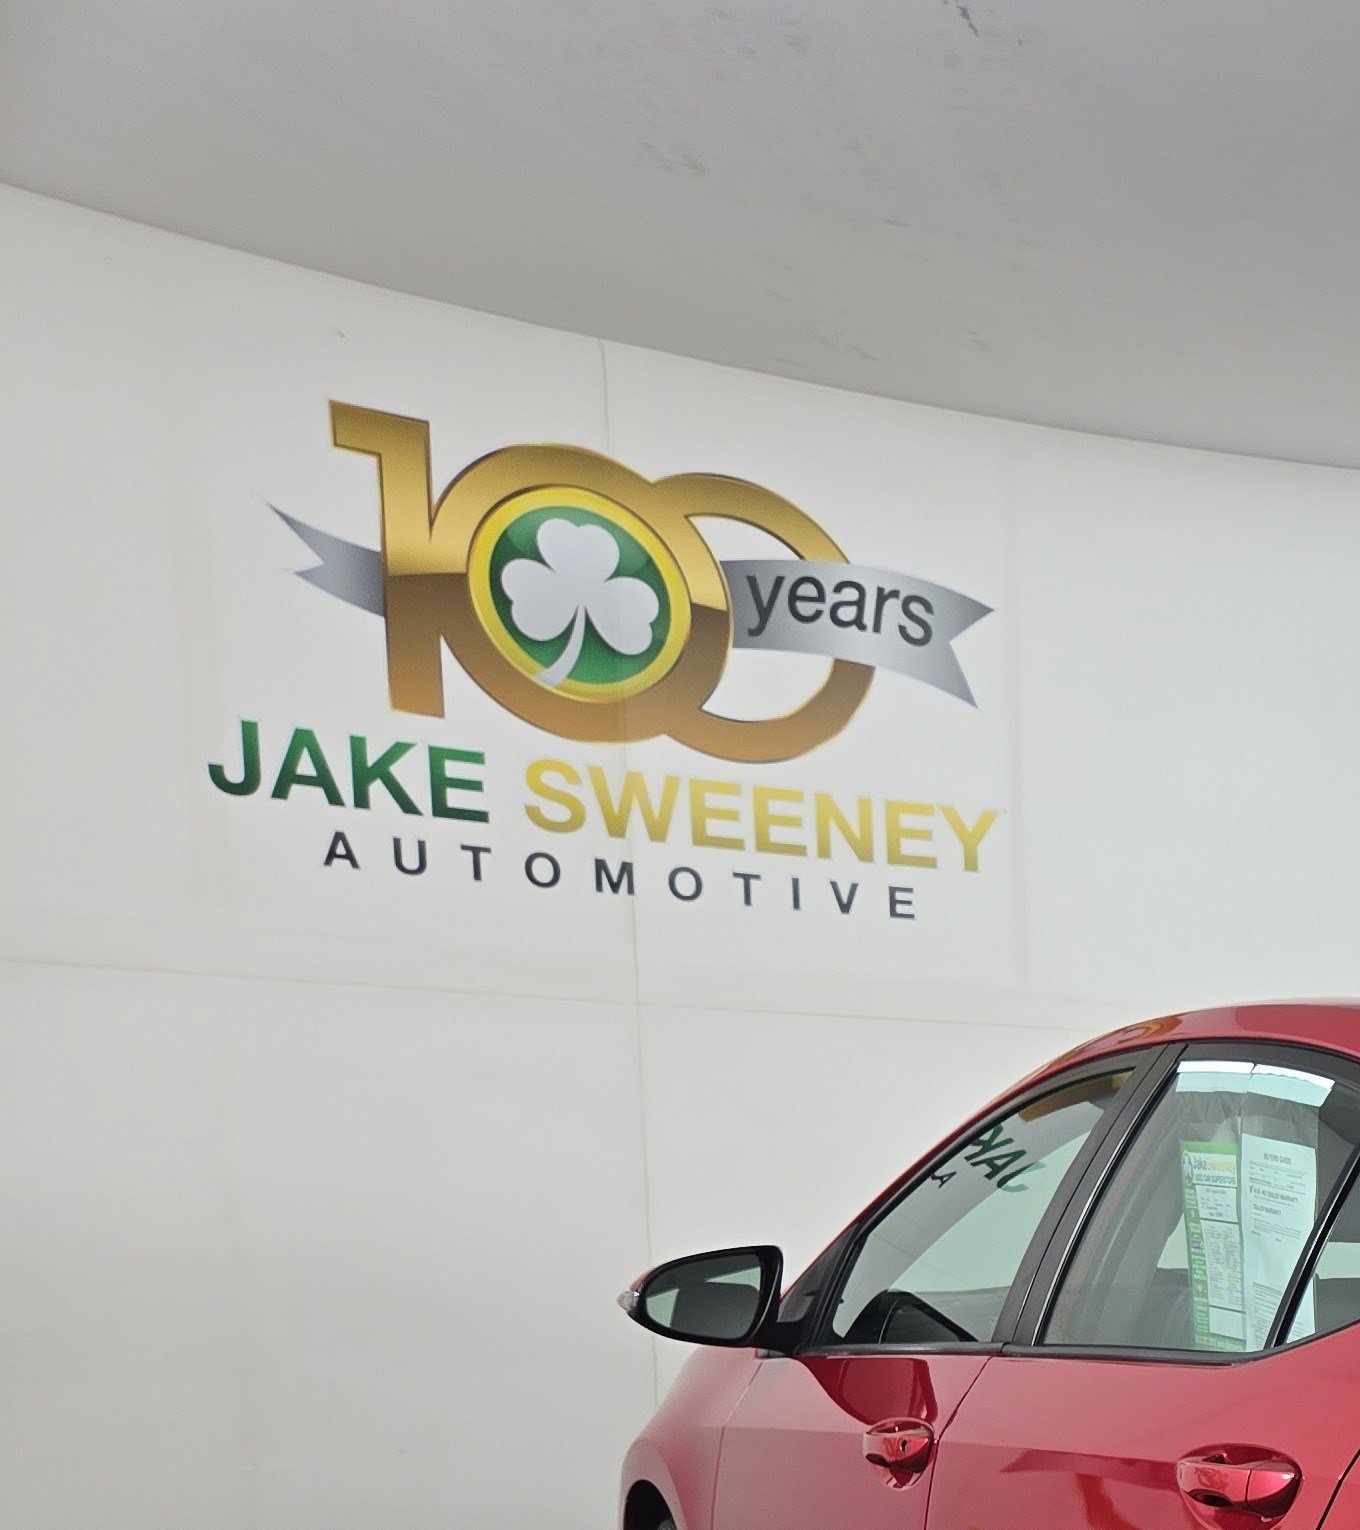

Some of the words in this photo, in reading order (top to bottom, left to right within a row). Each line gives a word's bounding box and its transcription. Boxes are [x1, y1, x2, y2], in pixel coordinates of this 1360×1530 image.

[327, 399, 877, 764] 100
[744, 570, 935, 647] years
[207, 719, 491, 825] JAKE
[523, 757, 1000, 874] SWEENEY
[323, 830, 916, 920] AUTOMOTIVE
